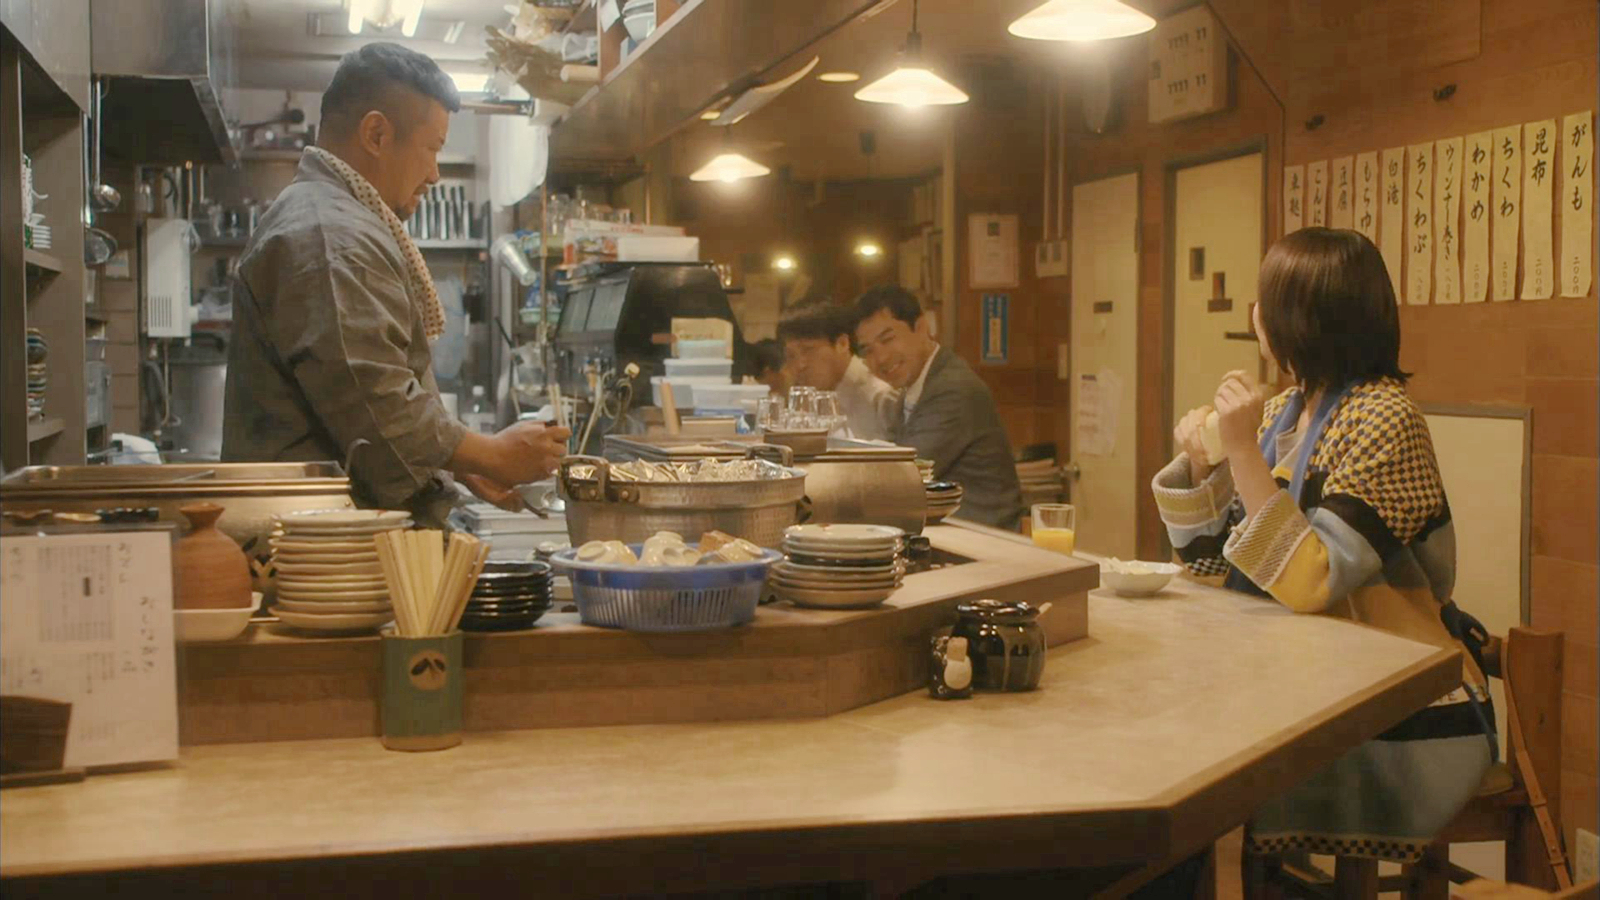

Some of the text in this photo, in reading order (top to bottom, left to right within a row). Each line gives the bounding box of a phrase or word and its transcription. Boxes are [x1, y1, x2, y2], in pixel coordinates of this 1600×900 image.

[1470, 142, 1486, 223] わかめ
[1500, 137, 1515, 219] ちくわ
[1531, 127, 1549, 188] 昆布
[1572, 124, 1588, 211] がんも
[1360, 161, 1373, 241] もち巾
[1413, 152, 1427, 254] ちくわぶ
